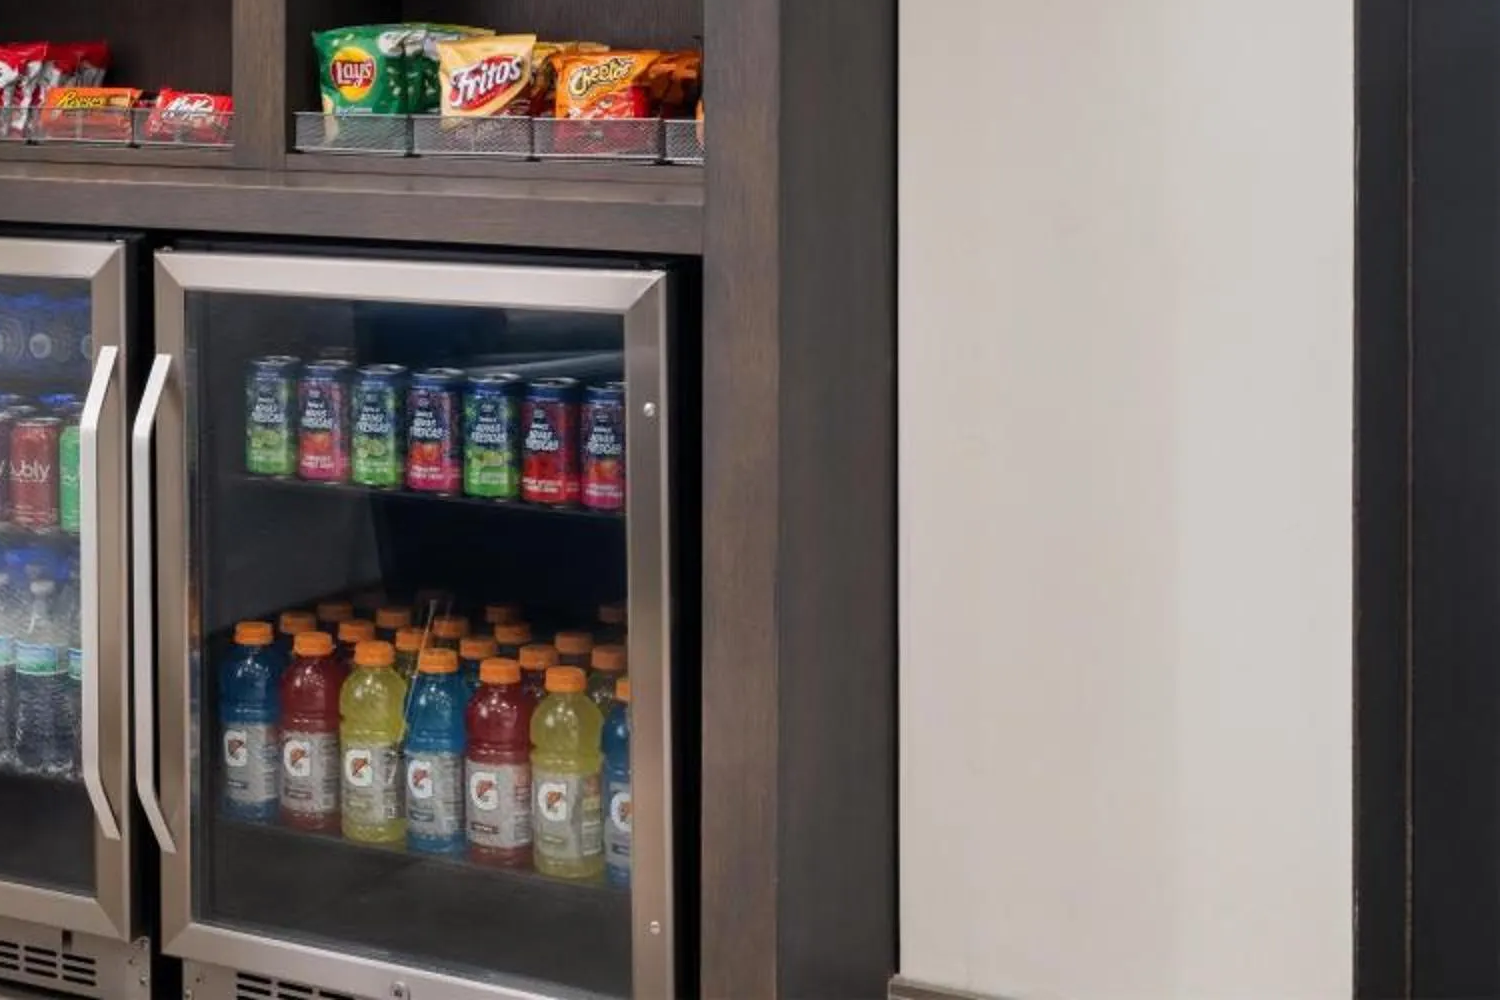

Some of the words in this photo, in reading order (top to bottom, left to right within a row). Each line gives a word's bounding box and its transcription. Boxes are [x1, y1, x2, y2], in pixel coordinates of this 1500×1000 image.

[450, 56, 524, 107] Fritos
[567, 56, 637, 98] Cheetos
[10, 459, 51, 483] ubly
[223, 730, 248, 767] G
[283, 739, 311, 777] G
[345, 748, 373, 787] G
[407, 760, 434, 799] G
[470, 771, 499, 811] G
[537, 781, 568, 822] G
